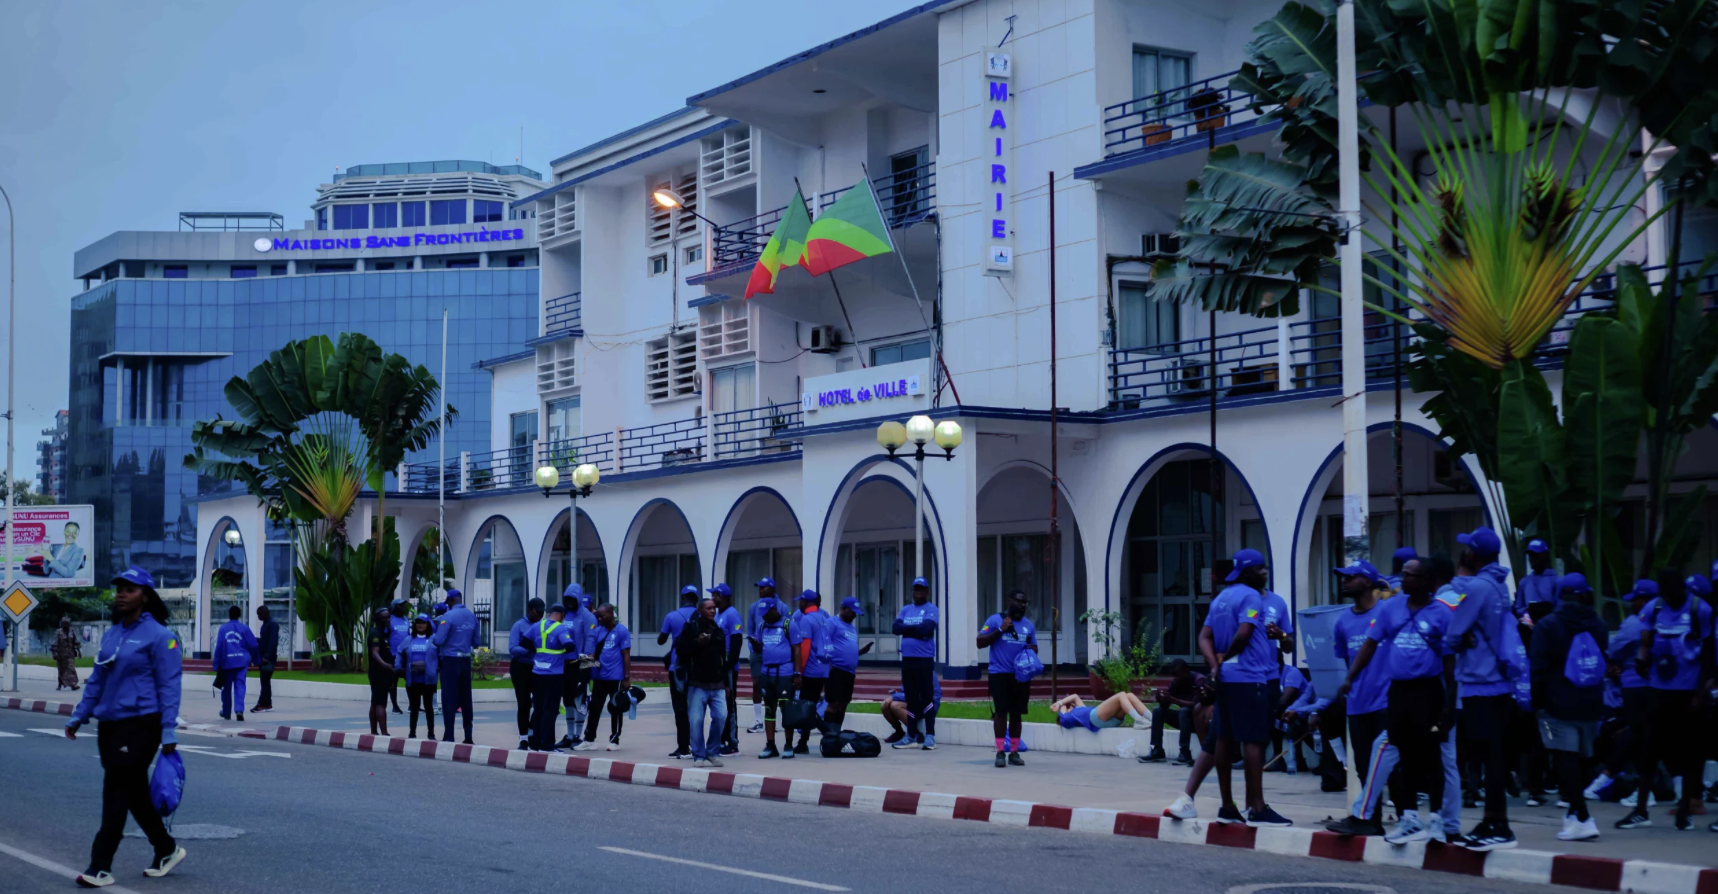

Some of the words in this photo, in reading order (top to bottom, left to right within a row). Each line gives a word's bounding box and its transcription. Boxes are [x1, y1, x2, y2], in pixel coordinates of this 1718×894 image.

[989, 82, 1008, 239] MAIRIE
[273, 237, 361, 251] MAISONS
[365, 235, 410, 250] SANS
[414, 226, 523, 247] FRONTIÈRES
[819, 388, 854, 407] HOTEL
[857, 387, 871, 402] de
[873, 379, 907, 398] VILLE
